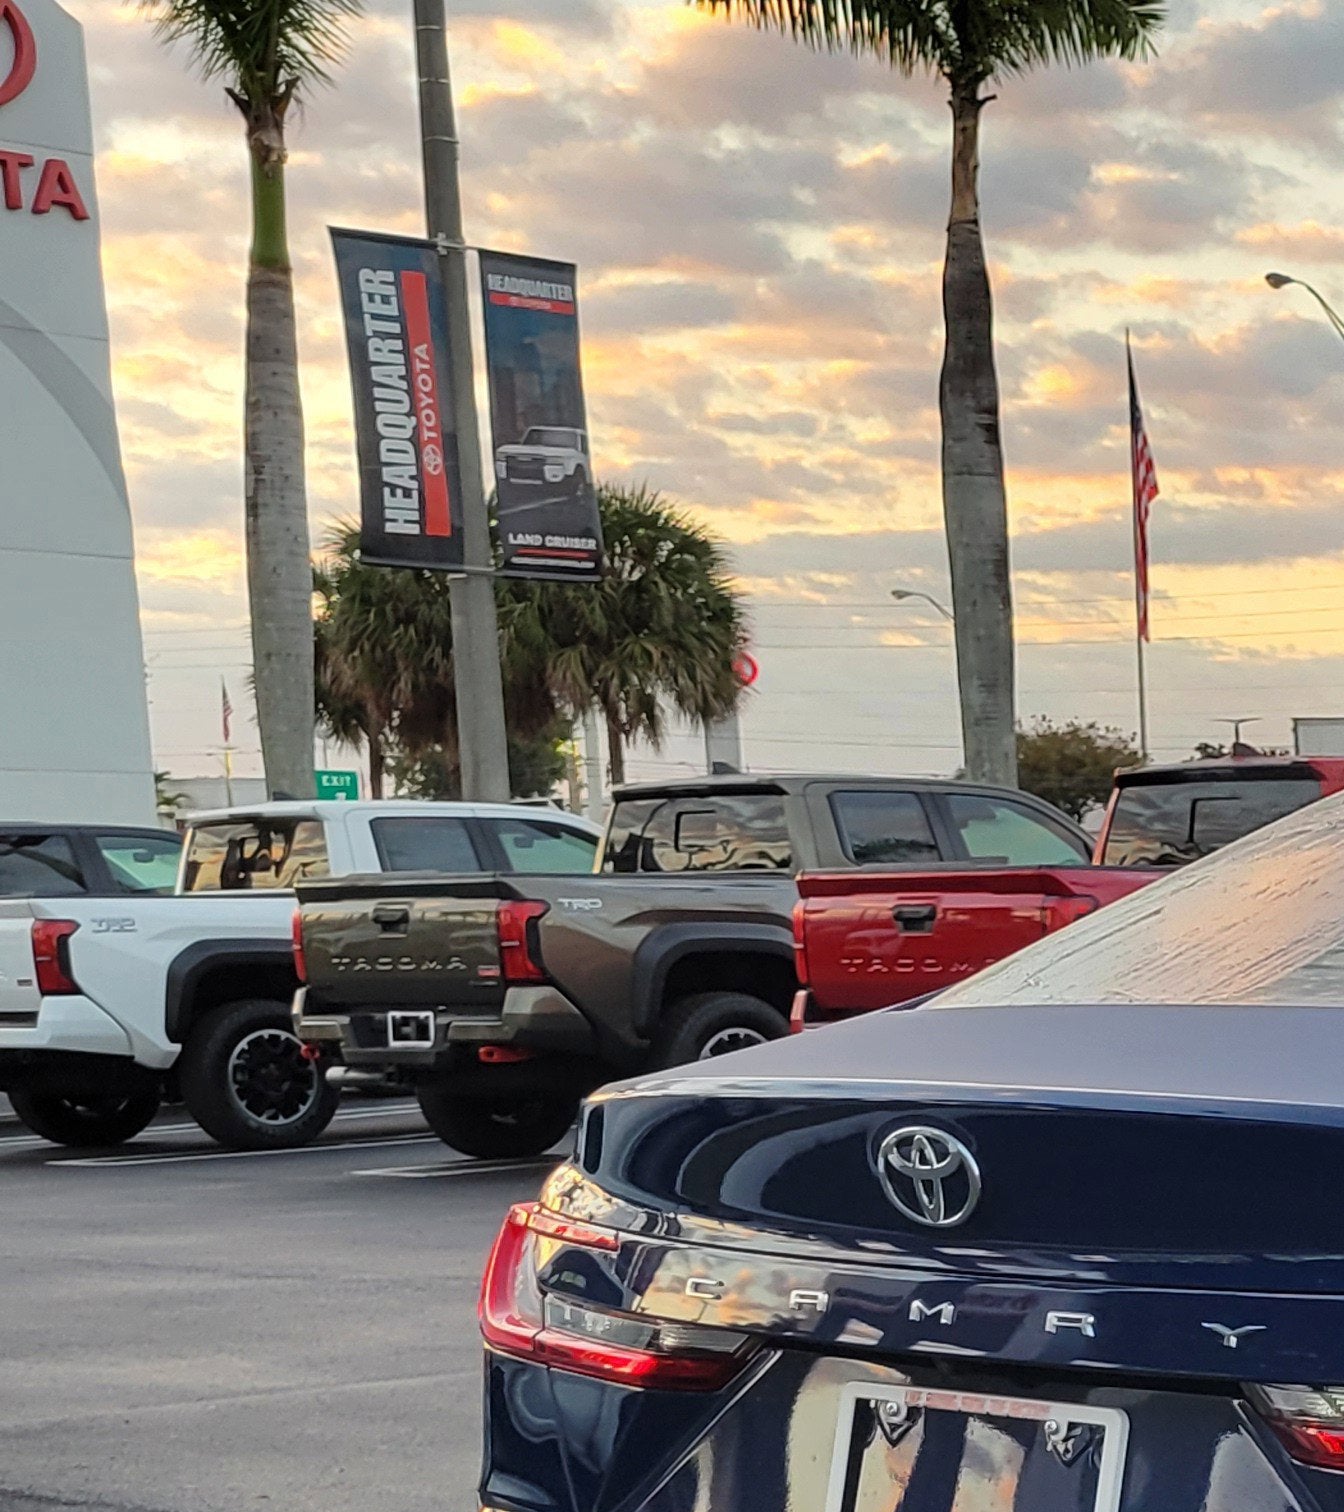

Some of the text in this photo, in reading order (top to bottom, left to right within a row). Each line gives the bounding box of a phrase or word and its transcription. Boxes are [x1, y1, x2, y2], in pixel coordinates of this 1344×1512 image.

[358, 267, 422, 536] HEADQUARTER
[413, 343, 439, 441] TOYOTA
[508, 532, 598, 551] LAND CRUISER
[321, 774, 352, 787] EXIT
[557, 898, 603, 911] TRD
[331, 957, 468, 971] TACOMA
[685, 1277, 1267, 1349] CAMRY
